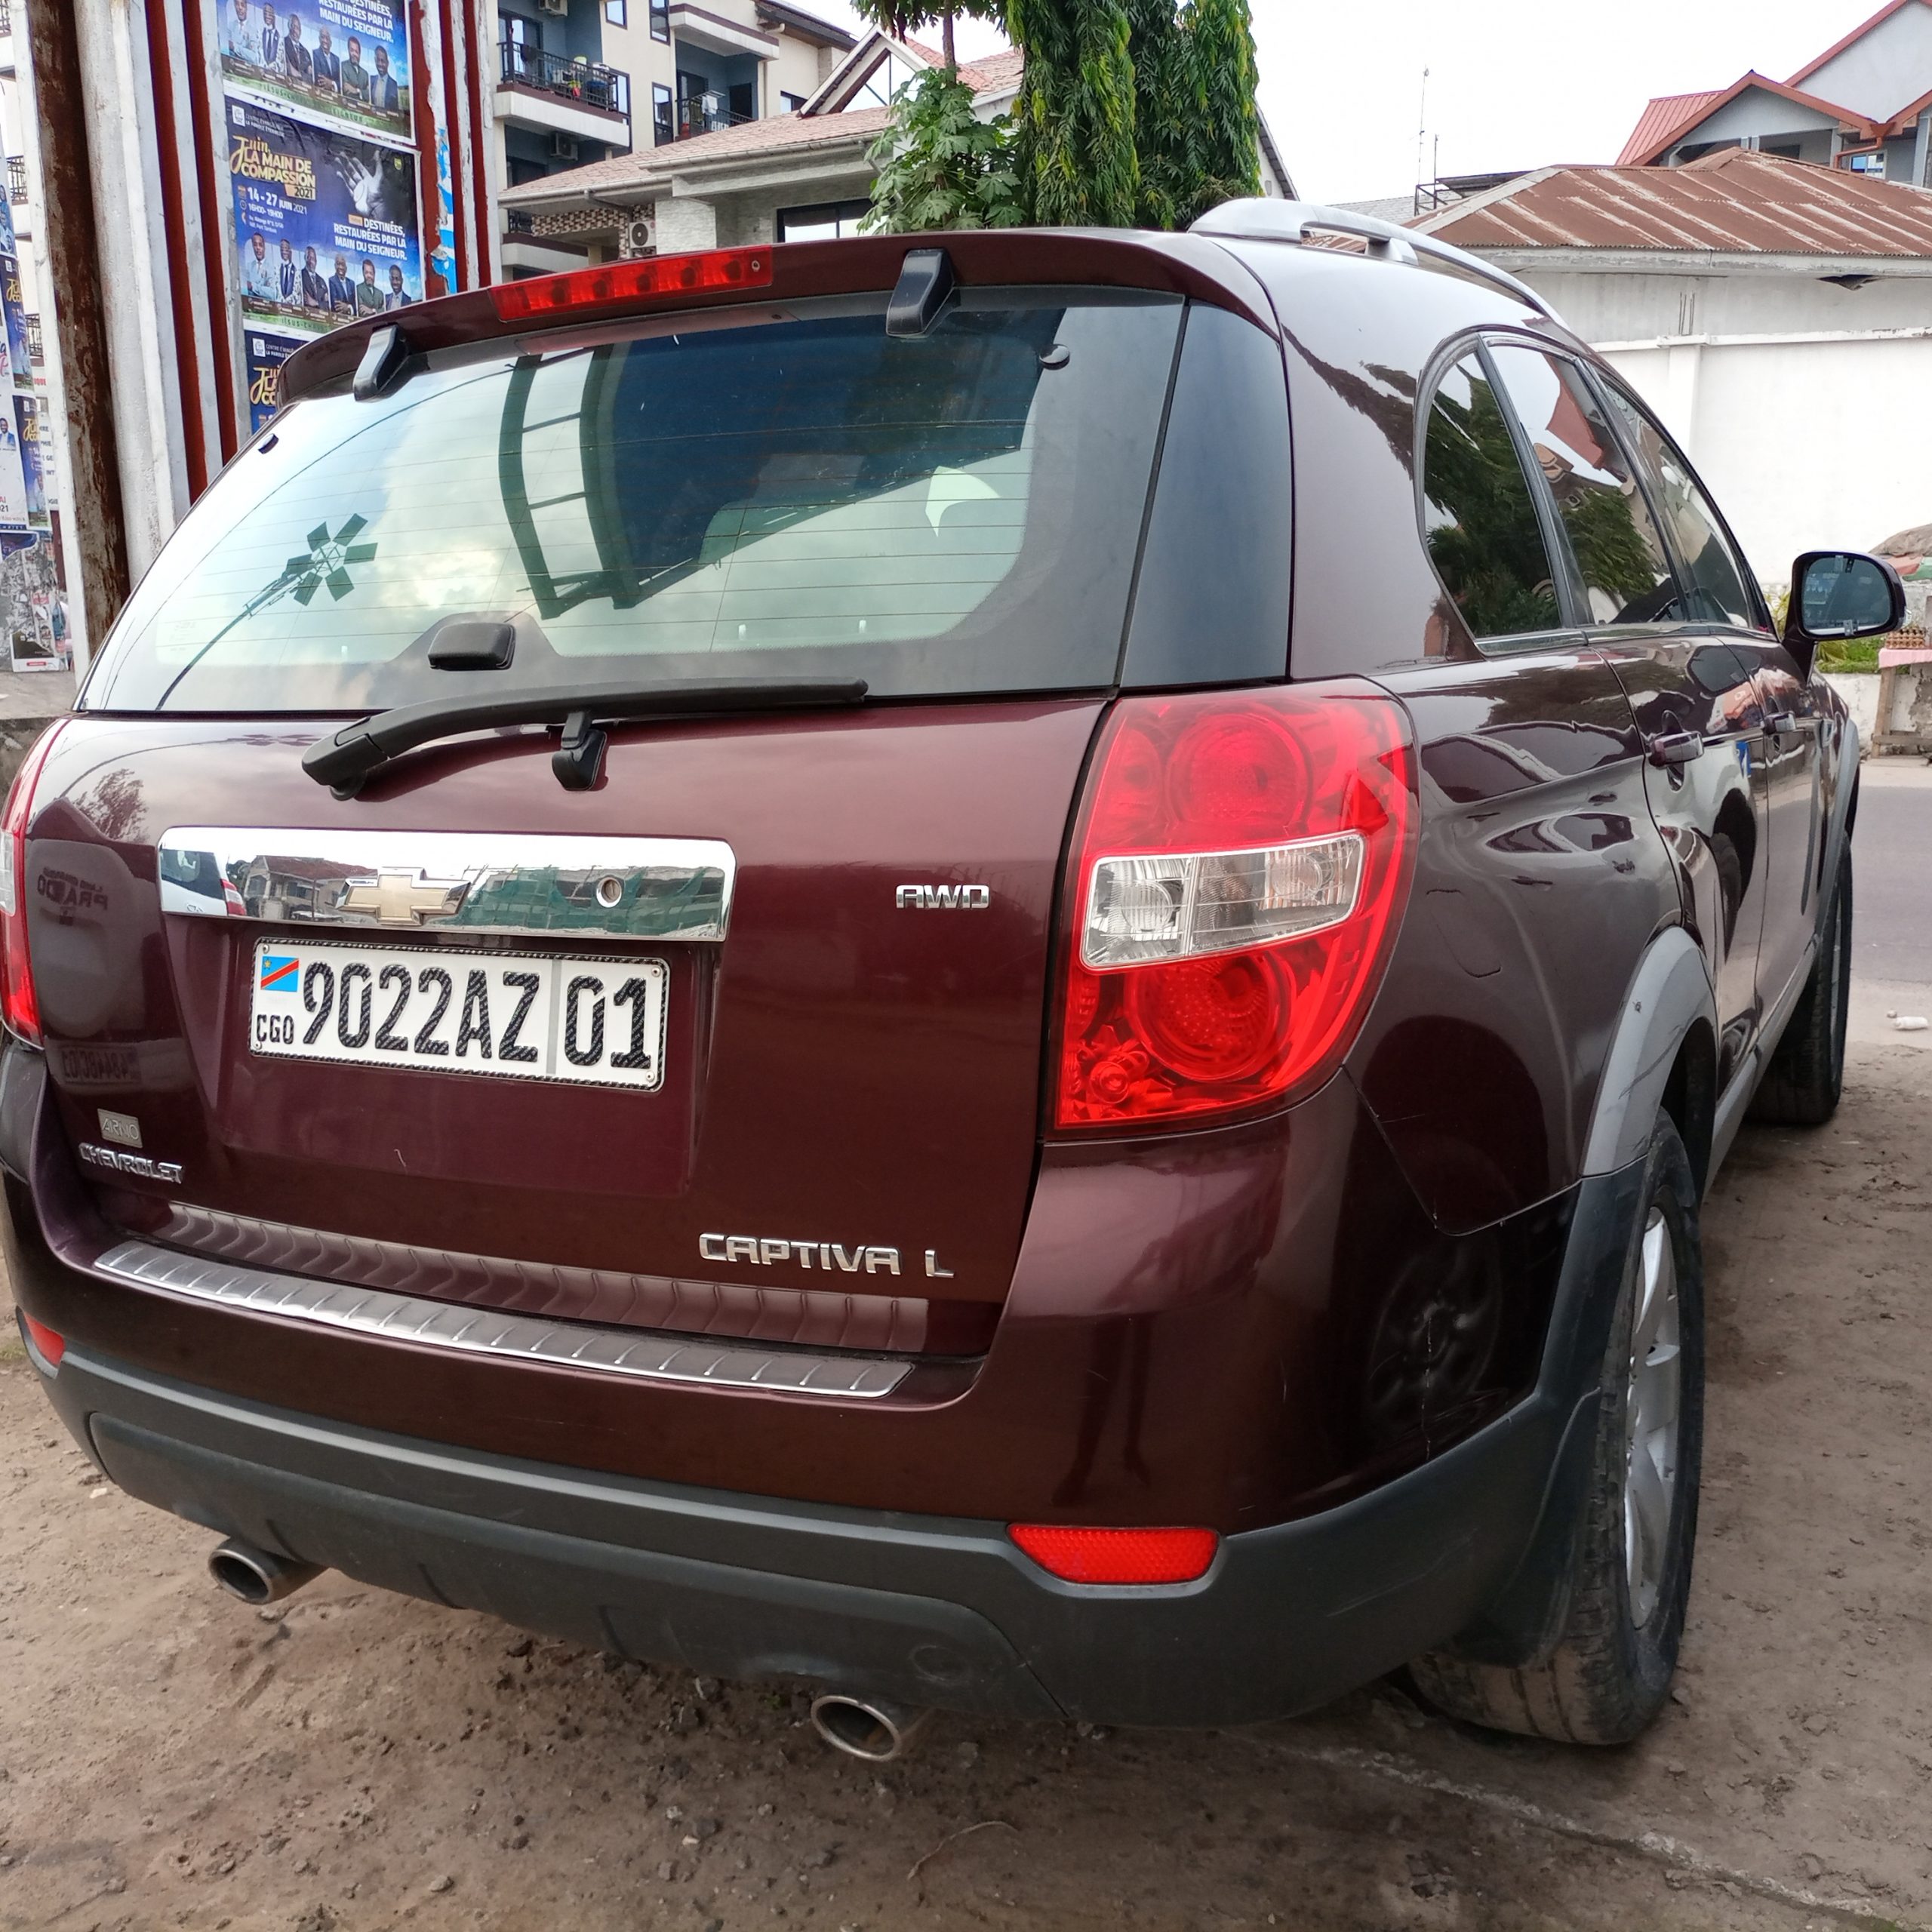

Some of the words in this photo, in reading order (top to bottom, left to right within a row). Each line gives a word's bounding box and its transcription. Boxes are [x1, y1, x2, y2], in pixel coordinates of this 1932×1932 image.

[319, 8, 341, 24] MAIN
[341, 15, 353, 29] DU
[353, 20, 395, 43] SEIGNEUR.
[367, 12, 383, 27] PAR
[383, 17, 394, 30] LA
[244, 147, 260, 165] LA
[261, 152, 293, 171] MAIN
[295, 158, 312, 174] DE
[241, 162, 316, 187] COMPASSION
[247, 186, 260, 202] 14
[266, 192, 278, 207] 27
[293, 202, 308, 216] 2021
[294, 186, 314, 198] 2021
[334, 223, 381, 244] RESTAURÉES
[381, 233, 397, 247] PAR
[397, 238, 408, 249] LA
[364, 217, 406, 238] DESTINÉES,
[334, 235, 355, 250] MAIN
[355, 242, 368, 252] DU
[368, 245, 408, 261] SEIGNEUR.
[895, 884, 989, 909] AWD
[257, 1014, 295, 1045] CGO
[303, 961, 541, 1063] 9022AZ
[565, 974, 652, 1070] 01
[100, 1116, 140, 1142] ARNO
[78, 1141, 185, 1184] CHEVROLET
[699, 1232, 901, 1276] CAPTIVA
[924, 1248, 955, 1279] L
